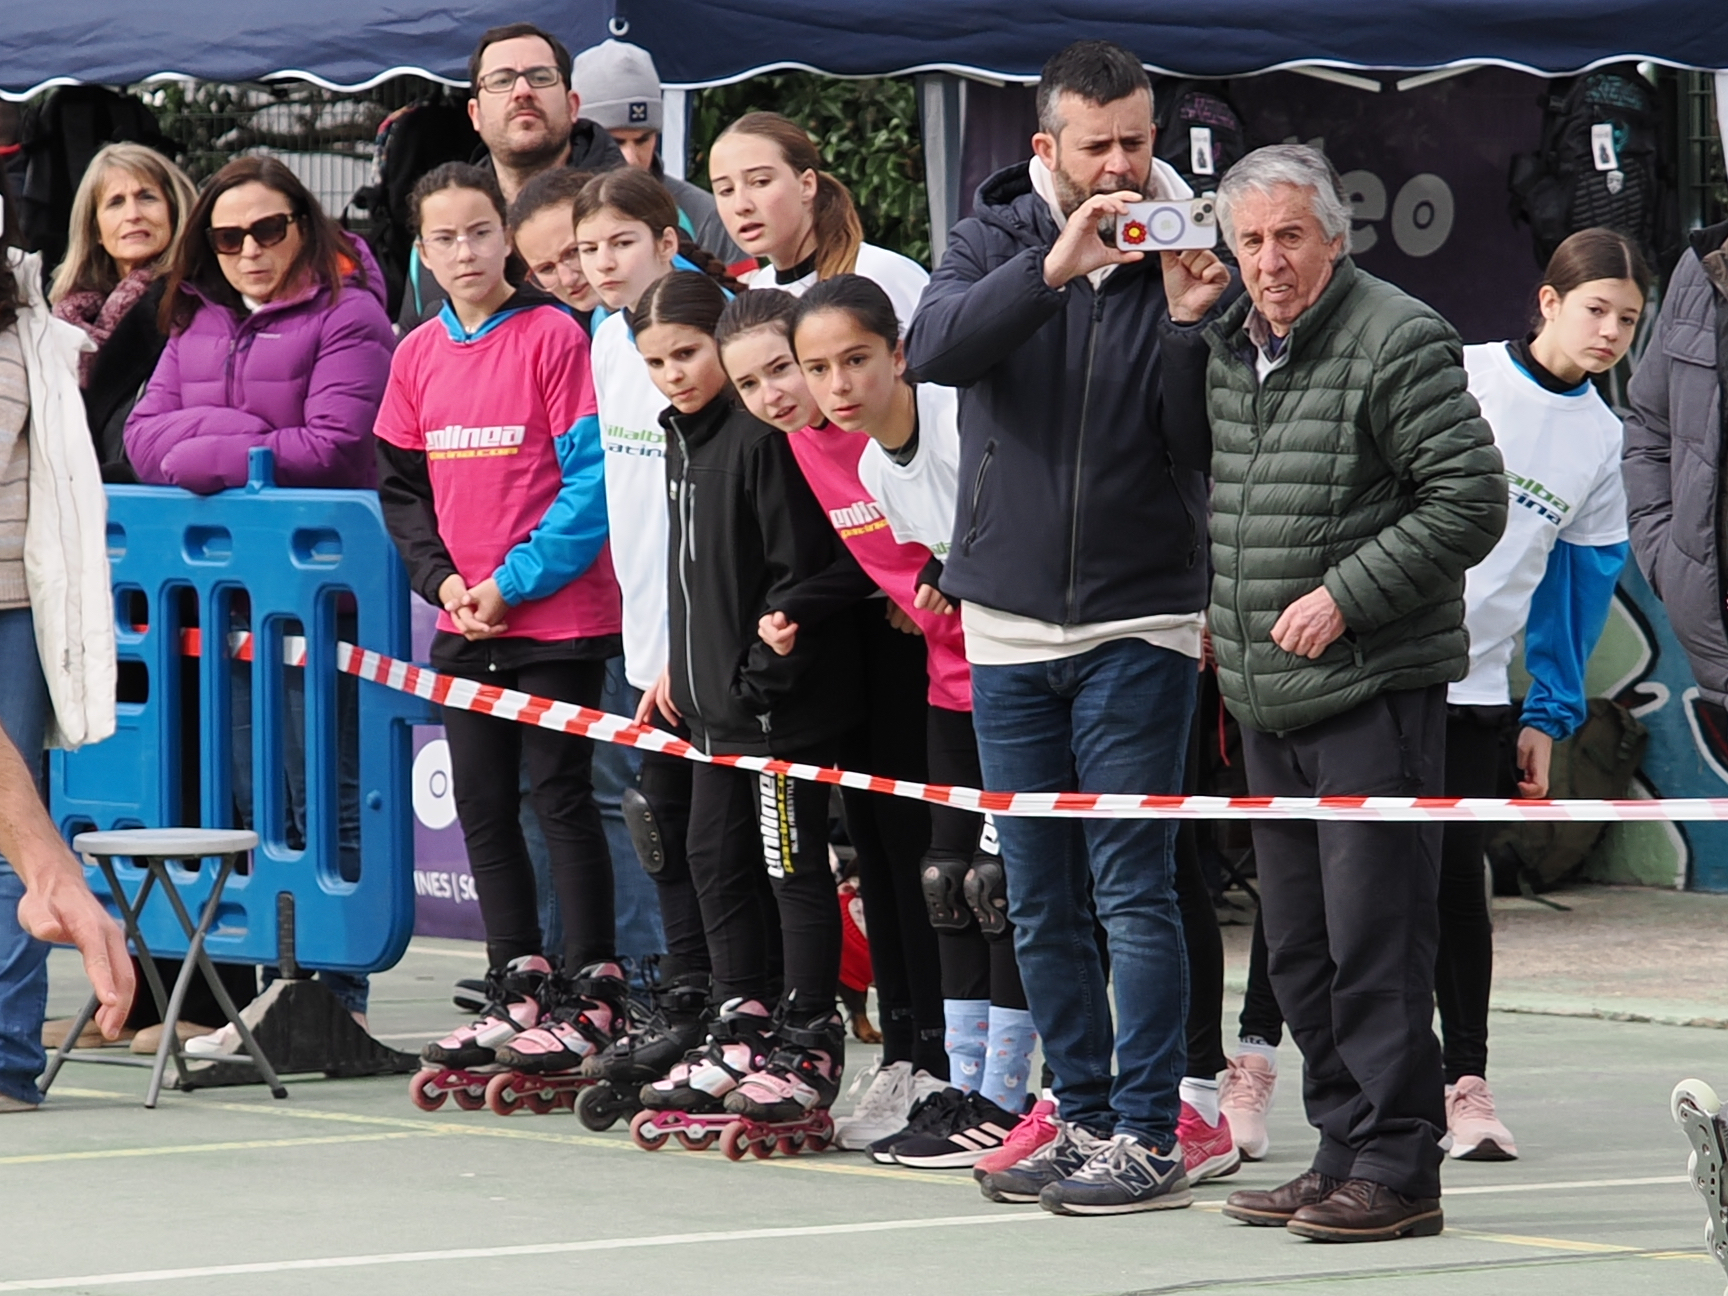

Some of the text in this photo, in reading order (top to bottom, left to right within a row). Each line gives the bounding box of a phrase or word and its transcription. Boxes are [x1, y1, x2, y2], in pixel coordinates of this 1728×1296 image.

[607, 425, 666, 444] illalb
[608, 443, 666, 459] atin
[1503, 469, 1571, 513] alba
[829, 501, 884, 529] enlin
[1508, 490, 1562, 526] ina
